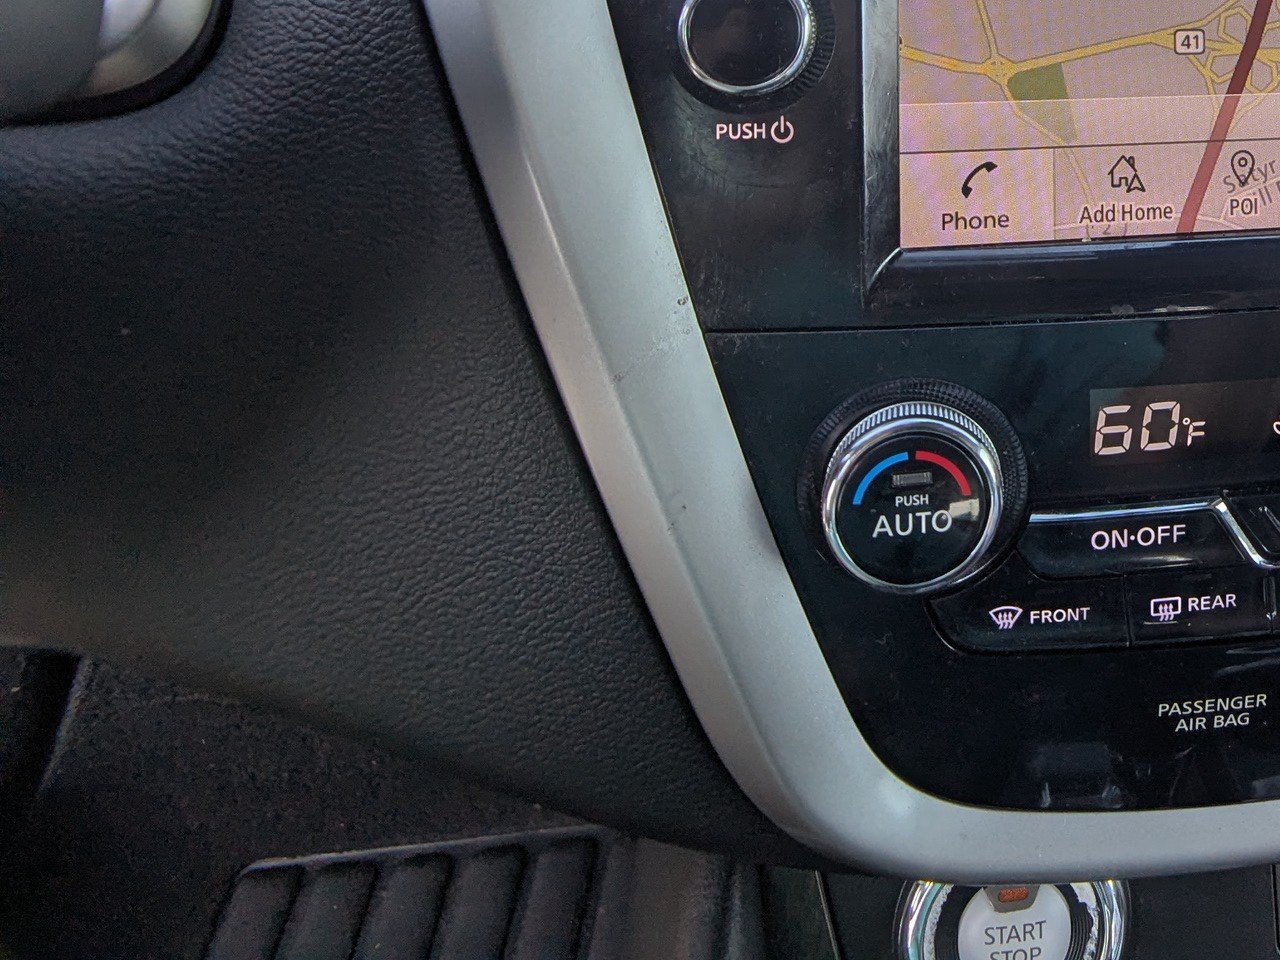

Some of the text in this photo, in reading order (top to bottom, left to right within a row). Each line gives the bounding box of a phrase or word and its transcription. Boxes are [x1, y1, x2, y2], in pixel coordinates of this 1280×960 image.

[1179, 34, 1202, 50] 41
[715, 122, 767, 140] PUSH
[1079, 203, 1173, 224] Add Home
[1229, 197, 1259, 216] POI
[941, 212, 1010, 231] Phone
[895, 493, 930, 506] PUSH
[872, 509, 953, 539] AUTO
[1188, 592, 1237, 612] REAR
[1029, 606, 1091, 625] FRONT
[1158, 693, 1268, 717] PASSENGER
[1175, 712, 1251, 732] AIR BAG
[983, 920, 1047, 945] START
